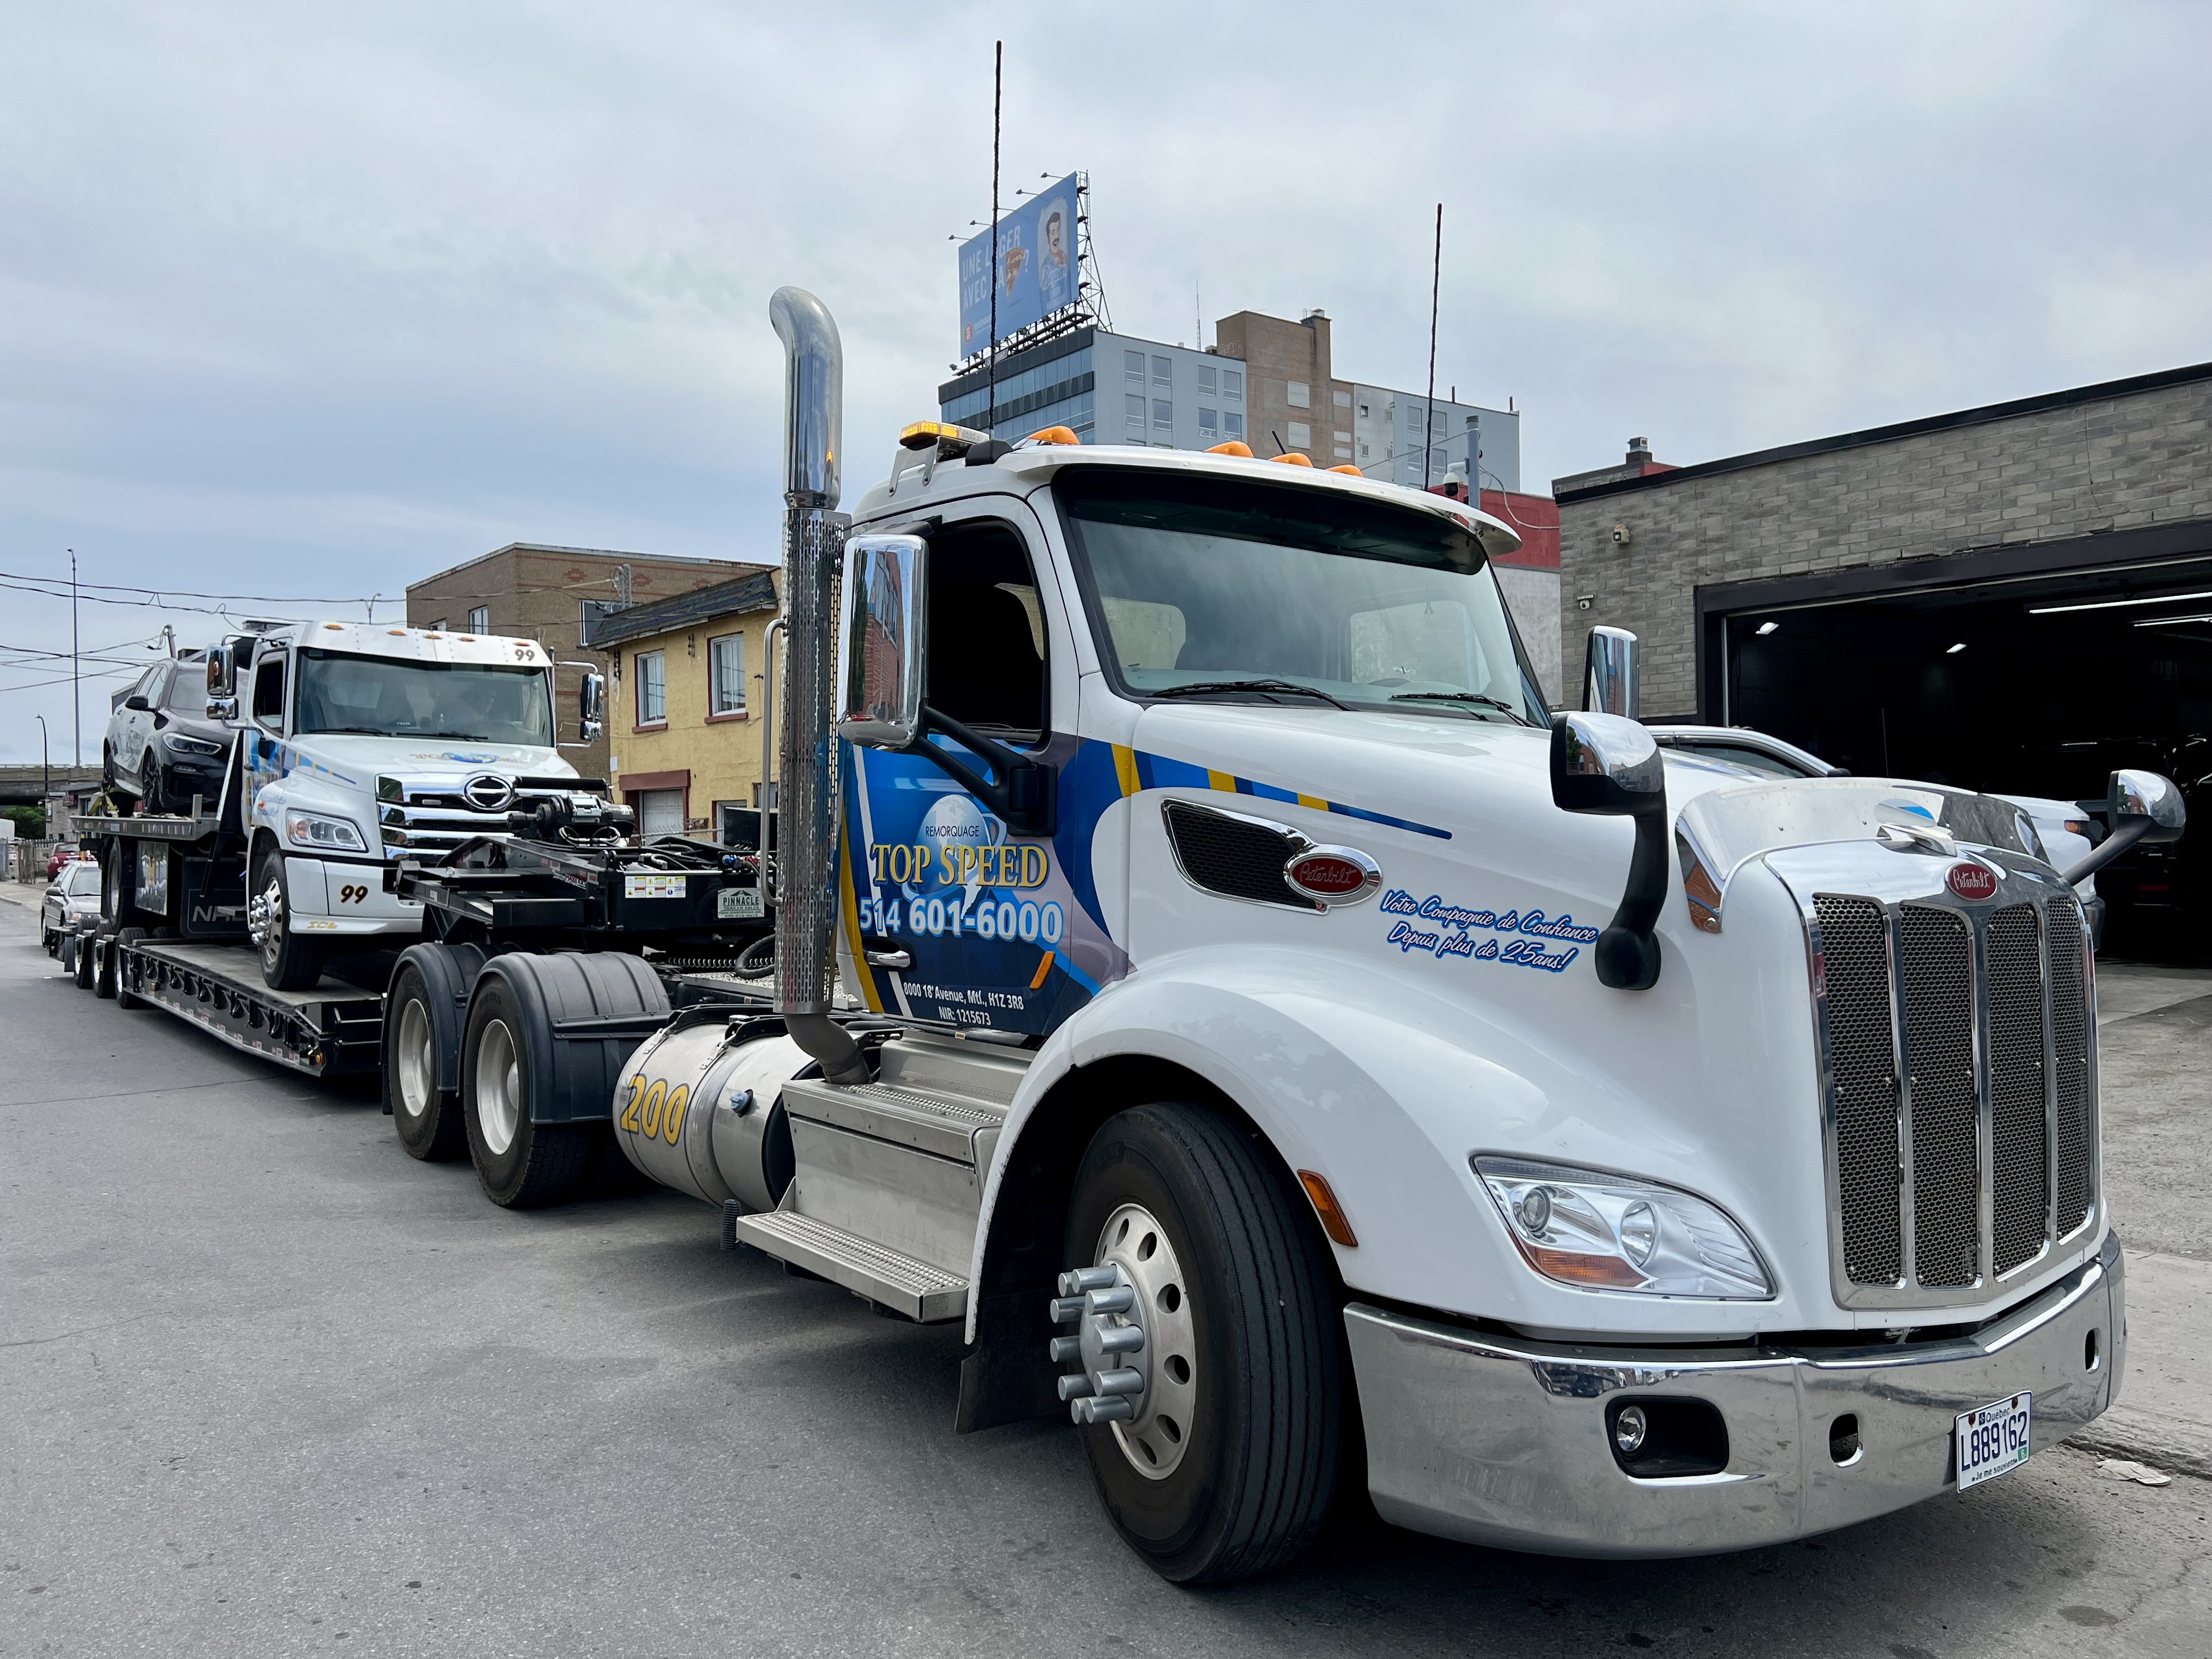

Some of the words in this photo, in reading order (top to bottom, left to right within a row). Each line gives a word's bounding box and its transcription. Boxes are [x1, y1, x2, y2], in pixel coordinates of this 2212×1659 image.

[963, 250, 981, 281] UNE
[985, 225, 1020, 267] LGER
[963, 275, 986, 312] AVEC
[515, 648, 535, 662] 99
[925, 825, 980, 837] REMORQUAGE
[872, 844, 932, 884] TOP
[939, 845, 1049, 887] SPEED
[1300, 862, 1357, 884] Peterbilt
[1953, 869, 1990, 889] Peterbilt
[341, 884, 368, 904] 99
[724, 896, 759, 905] PINNACLE
[860, 897, 901, 933] 514
[909, 897, 1064, 944] 601-6000
[1382, 891, 1417, 914] Votre
[1420, 897, 1494, 928] Compagnie
[1497, 912, 1516, 929] de
[1520, 913, 1597, 941] Confiance
[1389, 923, 1437, 950] Depuis
[1437, 933, 1471, 957] plus
[1476, 941, 1497, 958] de
[1502, 943, 1577, 970] 25ans!
[904, 982, 922, 997] 8000
[935, 986, 967, 1005] Avenue,
[967, 990, 987, 1007] Mtl.,
[988, 992, 1006, 1008] H1Z
[1007, 995, 1024, 1010] 3R8
[938, 1006, 956, 1021] NIR:
[956, 1009, 991, 1026] 1215673
[620, 1073, 690, 1147] 200
[1987, 1407, 2010, 1423] Québec
[1961, 1411, 2027, 1472] L889162
[1994, 1458, 2016, 1474] souviens
